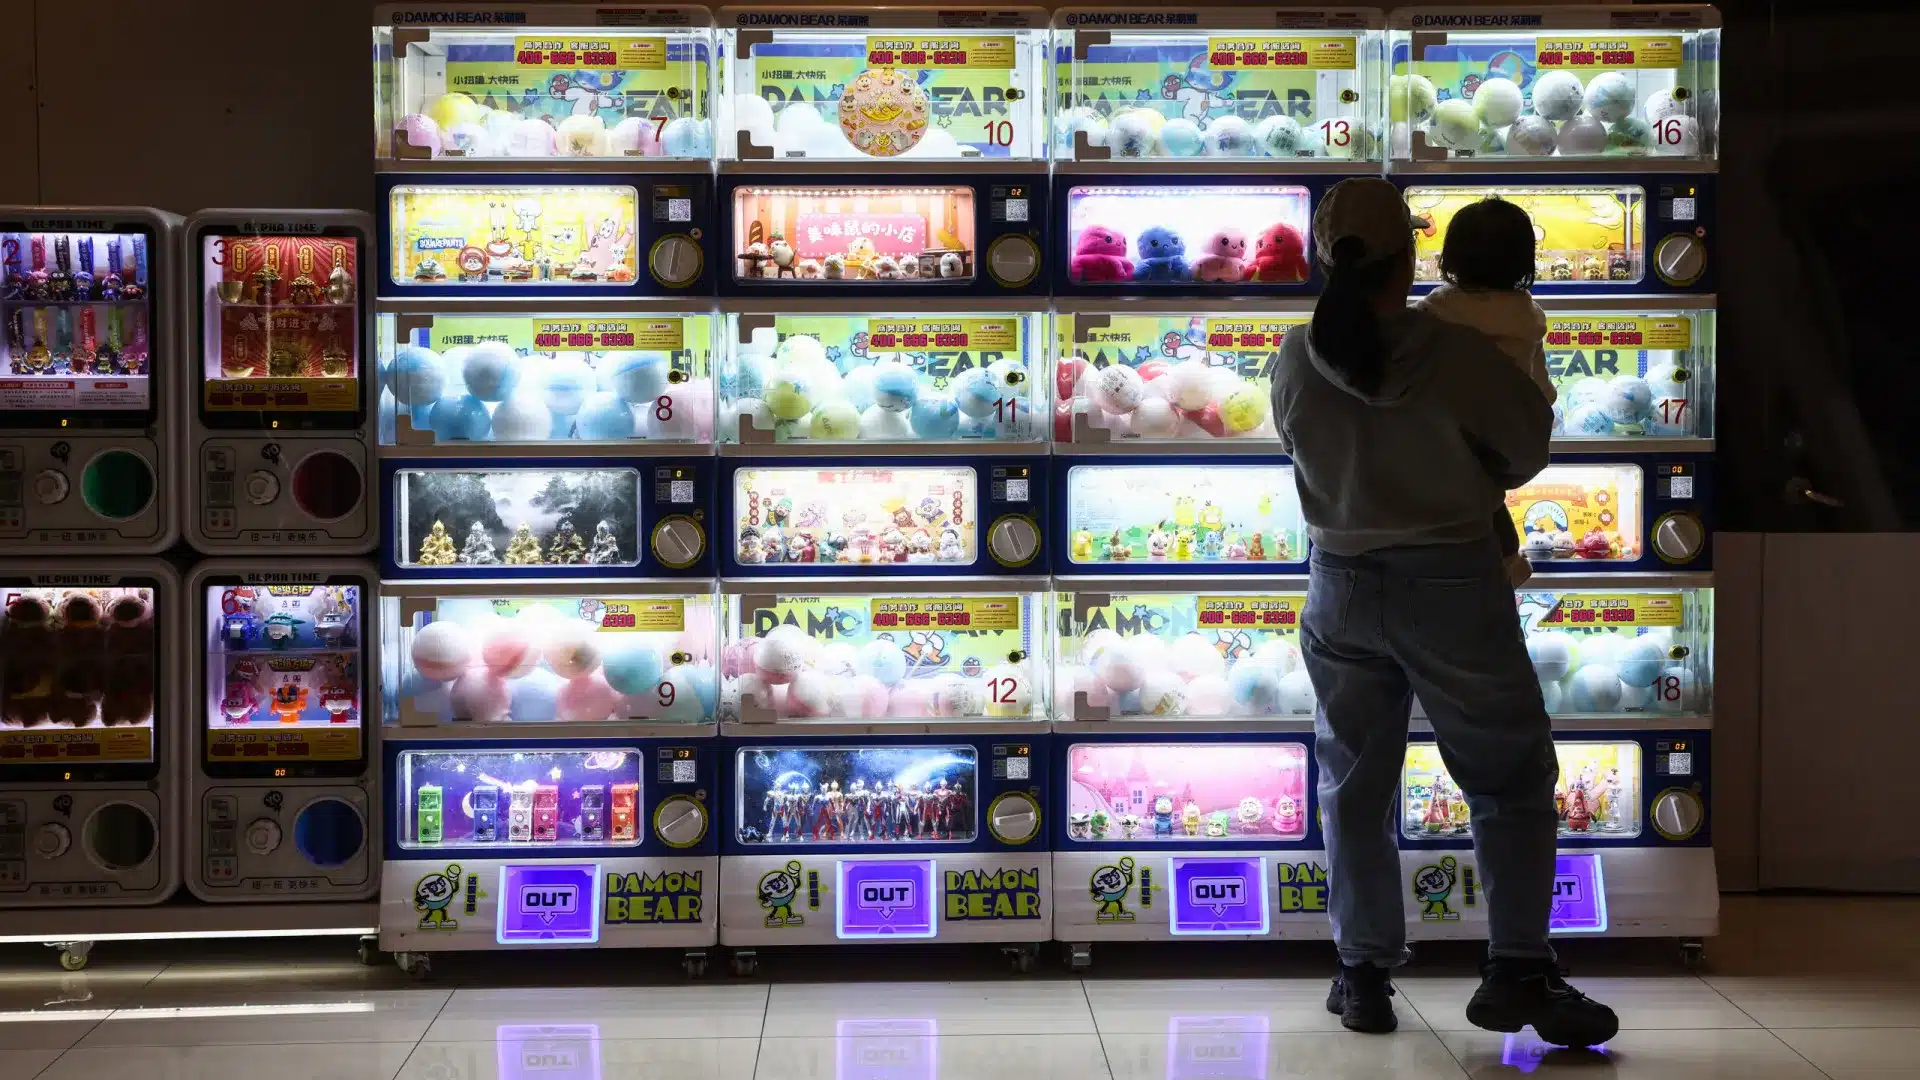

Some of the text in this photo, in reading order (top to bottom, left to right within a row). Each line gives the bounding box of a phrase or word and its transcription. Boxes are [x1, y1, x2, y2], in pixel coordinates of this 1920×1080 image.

[456, 12, 492, 23] BEAR
[801, 14, 836, 25] BEAR
[1129, 13, 1164, 25] BEAR
[1474, 15, 1509, 26] BEAR
[932, 86, 1008, 117] EAR
[1237, 89, 1313, 119] EAR
[651, 117, 667, 142] 7
[983, 121, 1014, 146] 10
[1320, 121, 1350, 147] 13
[1653, 120, 1682, 145] 16
[1011, 188, 1022, 197] 02
[77, 220, 106, 229] TIME
[288, 223, 317, 232] TIME
[2, 240, 22, 265] 2
[212, 240, 227, 265] 3
[1209, 334, 1284, 346] 400-666-6
[1547, 350, 1619, 377] EAR
[655, 395, 673, 421] 8
[992, 397, 1016, 423] 11
[1659, 399, 1688, 424] 17
[1672, 466, 1682, 475] 00
[83, 575, 112, 584] TIME
[290, 573, 320, 582] TIME
[221, 590, 239, 615] 6
[658, 681, 675, 707] 9
[987, 677, 1017, 703] 12
[1652, 675, 1681, 701] 18
[678, 750, 690, 759] 03
[1674, 743, 1686, 751] 03
[607, 871, 703, 894] DAMON
[945, 868, 1039, 891] DAMON
[1279, 861, 1327, 884] DAM
[525, 892, 572, 907] OUT
[863, 887, 909, 902] OUT
[1195, 884, 1240, 899] OUT
[1280, 886, 1328, 912] BE
[1553, 881, 1576, 896] UT
[606, 895, 703, 922] BEAR
[946, 891, 1041, 919] BEAR
